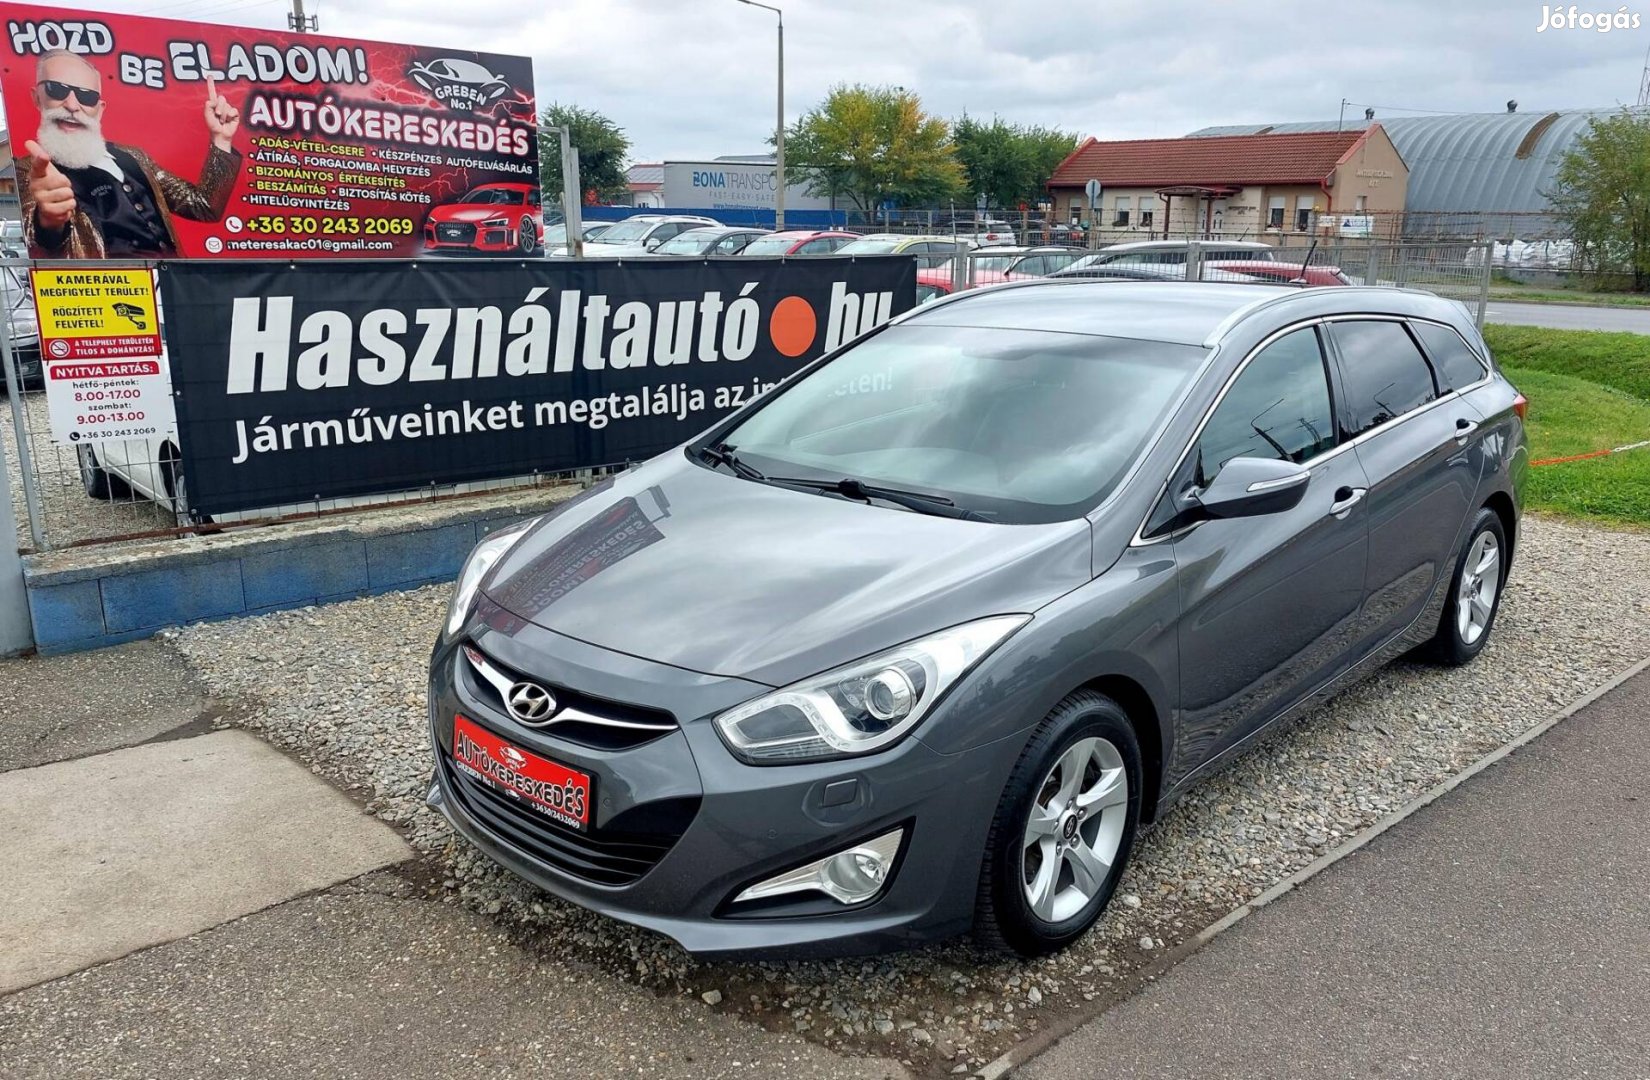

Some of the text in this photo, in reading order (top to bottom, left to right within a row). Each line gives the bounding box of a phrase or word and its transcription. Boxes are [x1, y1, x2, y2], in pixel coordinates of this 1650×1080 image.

[8, 22, 113, 54] HOZD
[169, 42, 369, 83] ELADOM!
[120, 55, 164, 88] BE
[434, 85, 487, 105] GREBEN
[450, 99, 473, 110] No.1
[250, 96, 529, 155] AUTÓKERESKEDÉS
[256, 150, 431, 177] ÁTÍRÁS, FORGALOMBA HELYEZÉS
[259, 138, 533, 174] ADÁS-VÉTEL-CSERE KÉSZPÉNZES AUTÓFELVÁSÁRLÁS
[256, 166, 406, 188] BIZOMÁNYOS ÉRTÉKESÍTÉS
[256, 181, 430, 204] BESZÁMÍTÁS BIZTOSÍTÁS KÖTÉS
[250, 194, 350, 211] HITELÜGYINTÉZÉS
[247, 216, 413, 235] +36 30 243 2069
[56, 273, 130, 285] KAMERÁVAL
[40, 286, 149, 298] MEGFIGYELT TERÜLET!
[52, 305, 103, 317] RÖGZÍTETT
[55, 318, 104, 329] FELVÉTEL!
[81, 338, 116, 347] TELEPHELY
[118, 336, 154, 345] TERÜLETÉN
[76, 348, 98, 356] TILOS
[107, 345, 155, 354] DOHÁNYZÁS!
[56, 362, 153, 378] NYITVA TARTÁS:
[72, 378, 139, 389] hétfő-péntek:
[74, 389, 141, 402] 8.00-17.00
[88, 402, 132, 411] szombat:
[76, 411, 145, 425] 9.00-13.00
[232, 400, 524, 465] Járműveinket
[534, 383, 704, 430] megtalálja
[714, 387, 744, 408] az
[82, 427, 156, 440] +36 30 243 2069
[456, 730, 585, 820] AUTÓKERESKEDÉS
